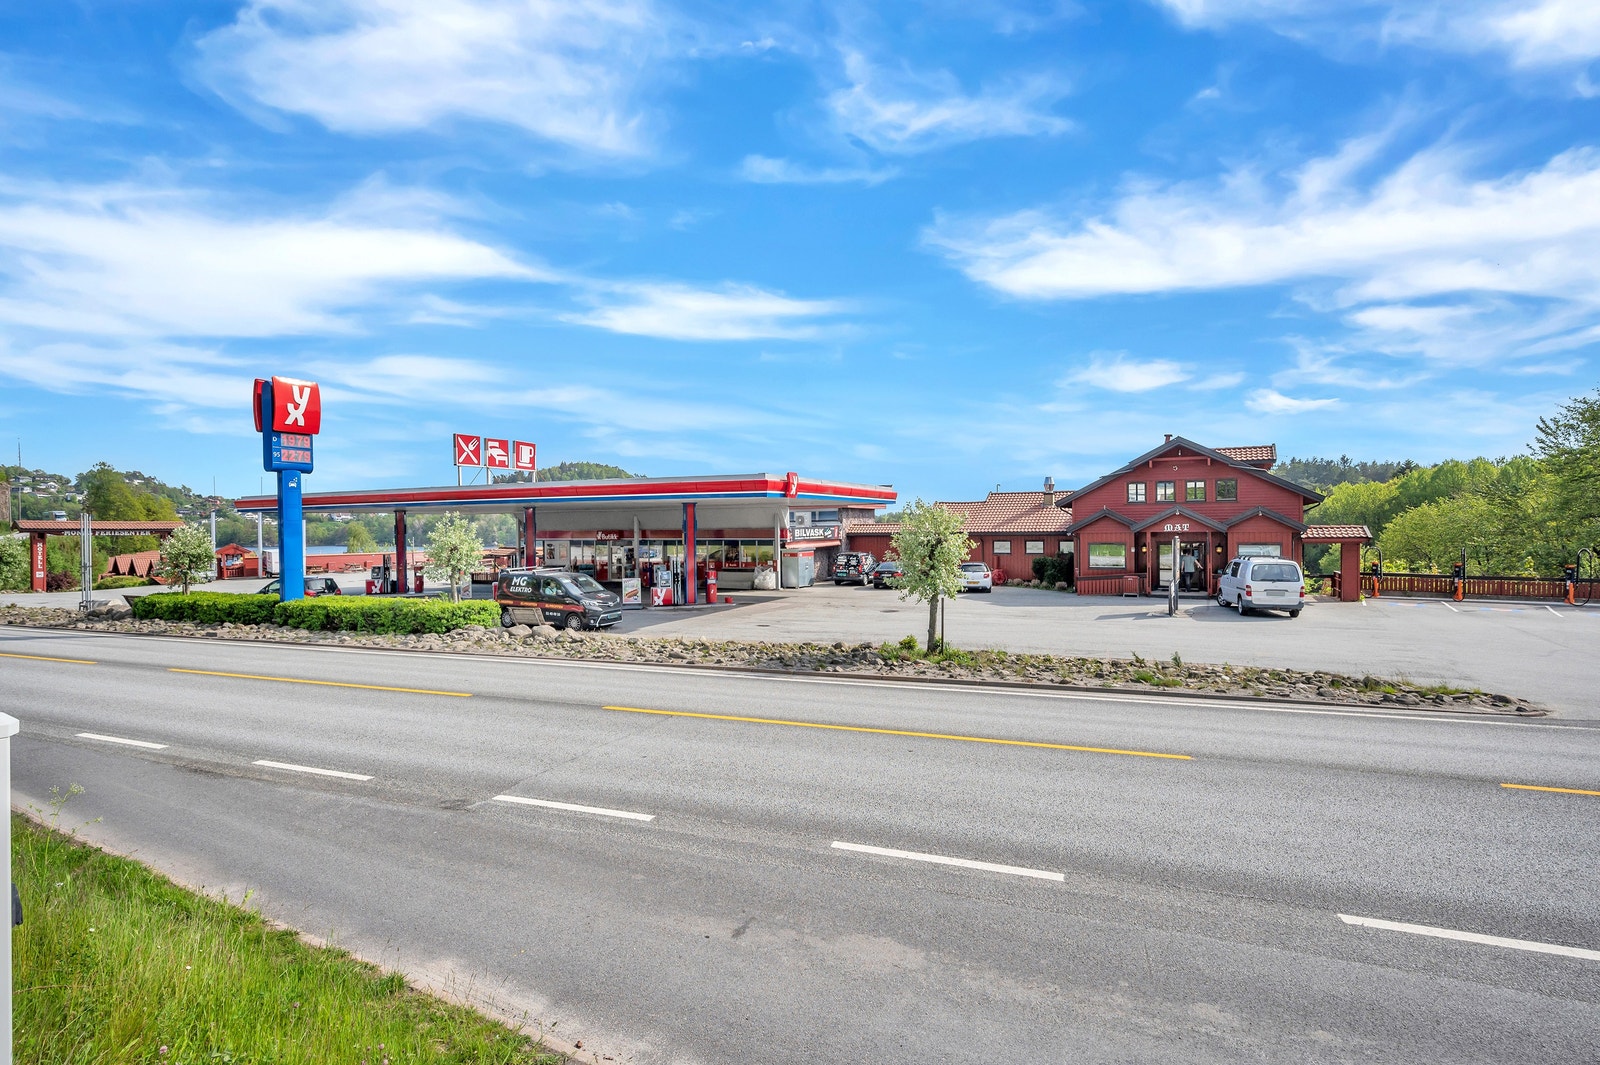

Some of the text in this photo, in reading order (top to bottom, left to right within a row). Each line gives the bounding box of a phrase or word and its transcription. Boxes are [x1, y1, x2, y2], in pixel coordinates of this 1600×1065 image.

[1164, 523, 1190, 532] MAT
[794, 528, 825, 537] BILVASK
[511, 576, 528, 586] MG
